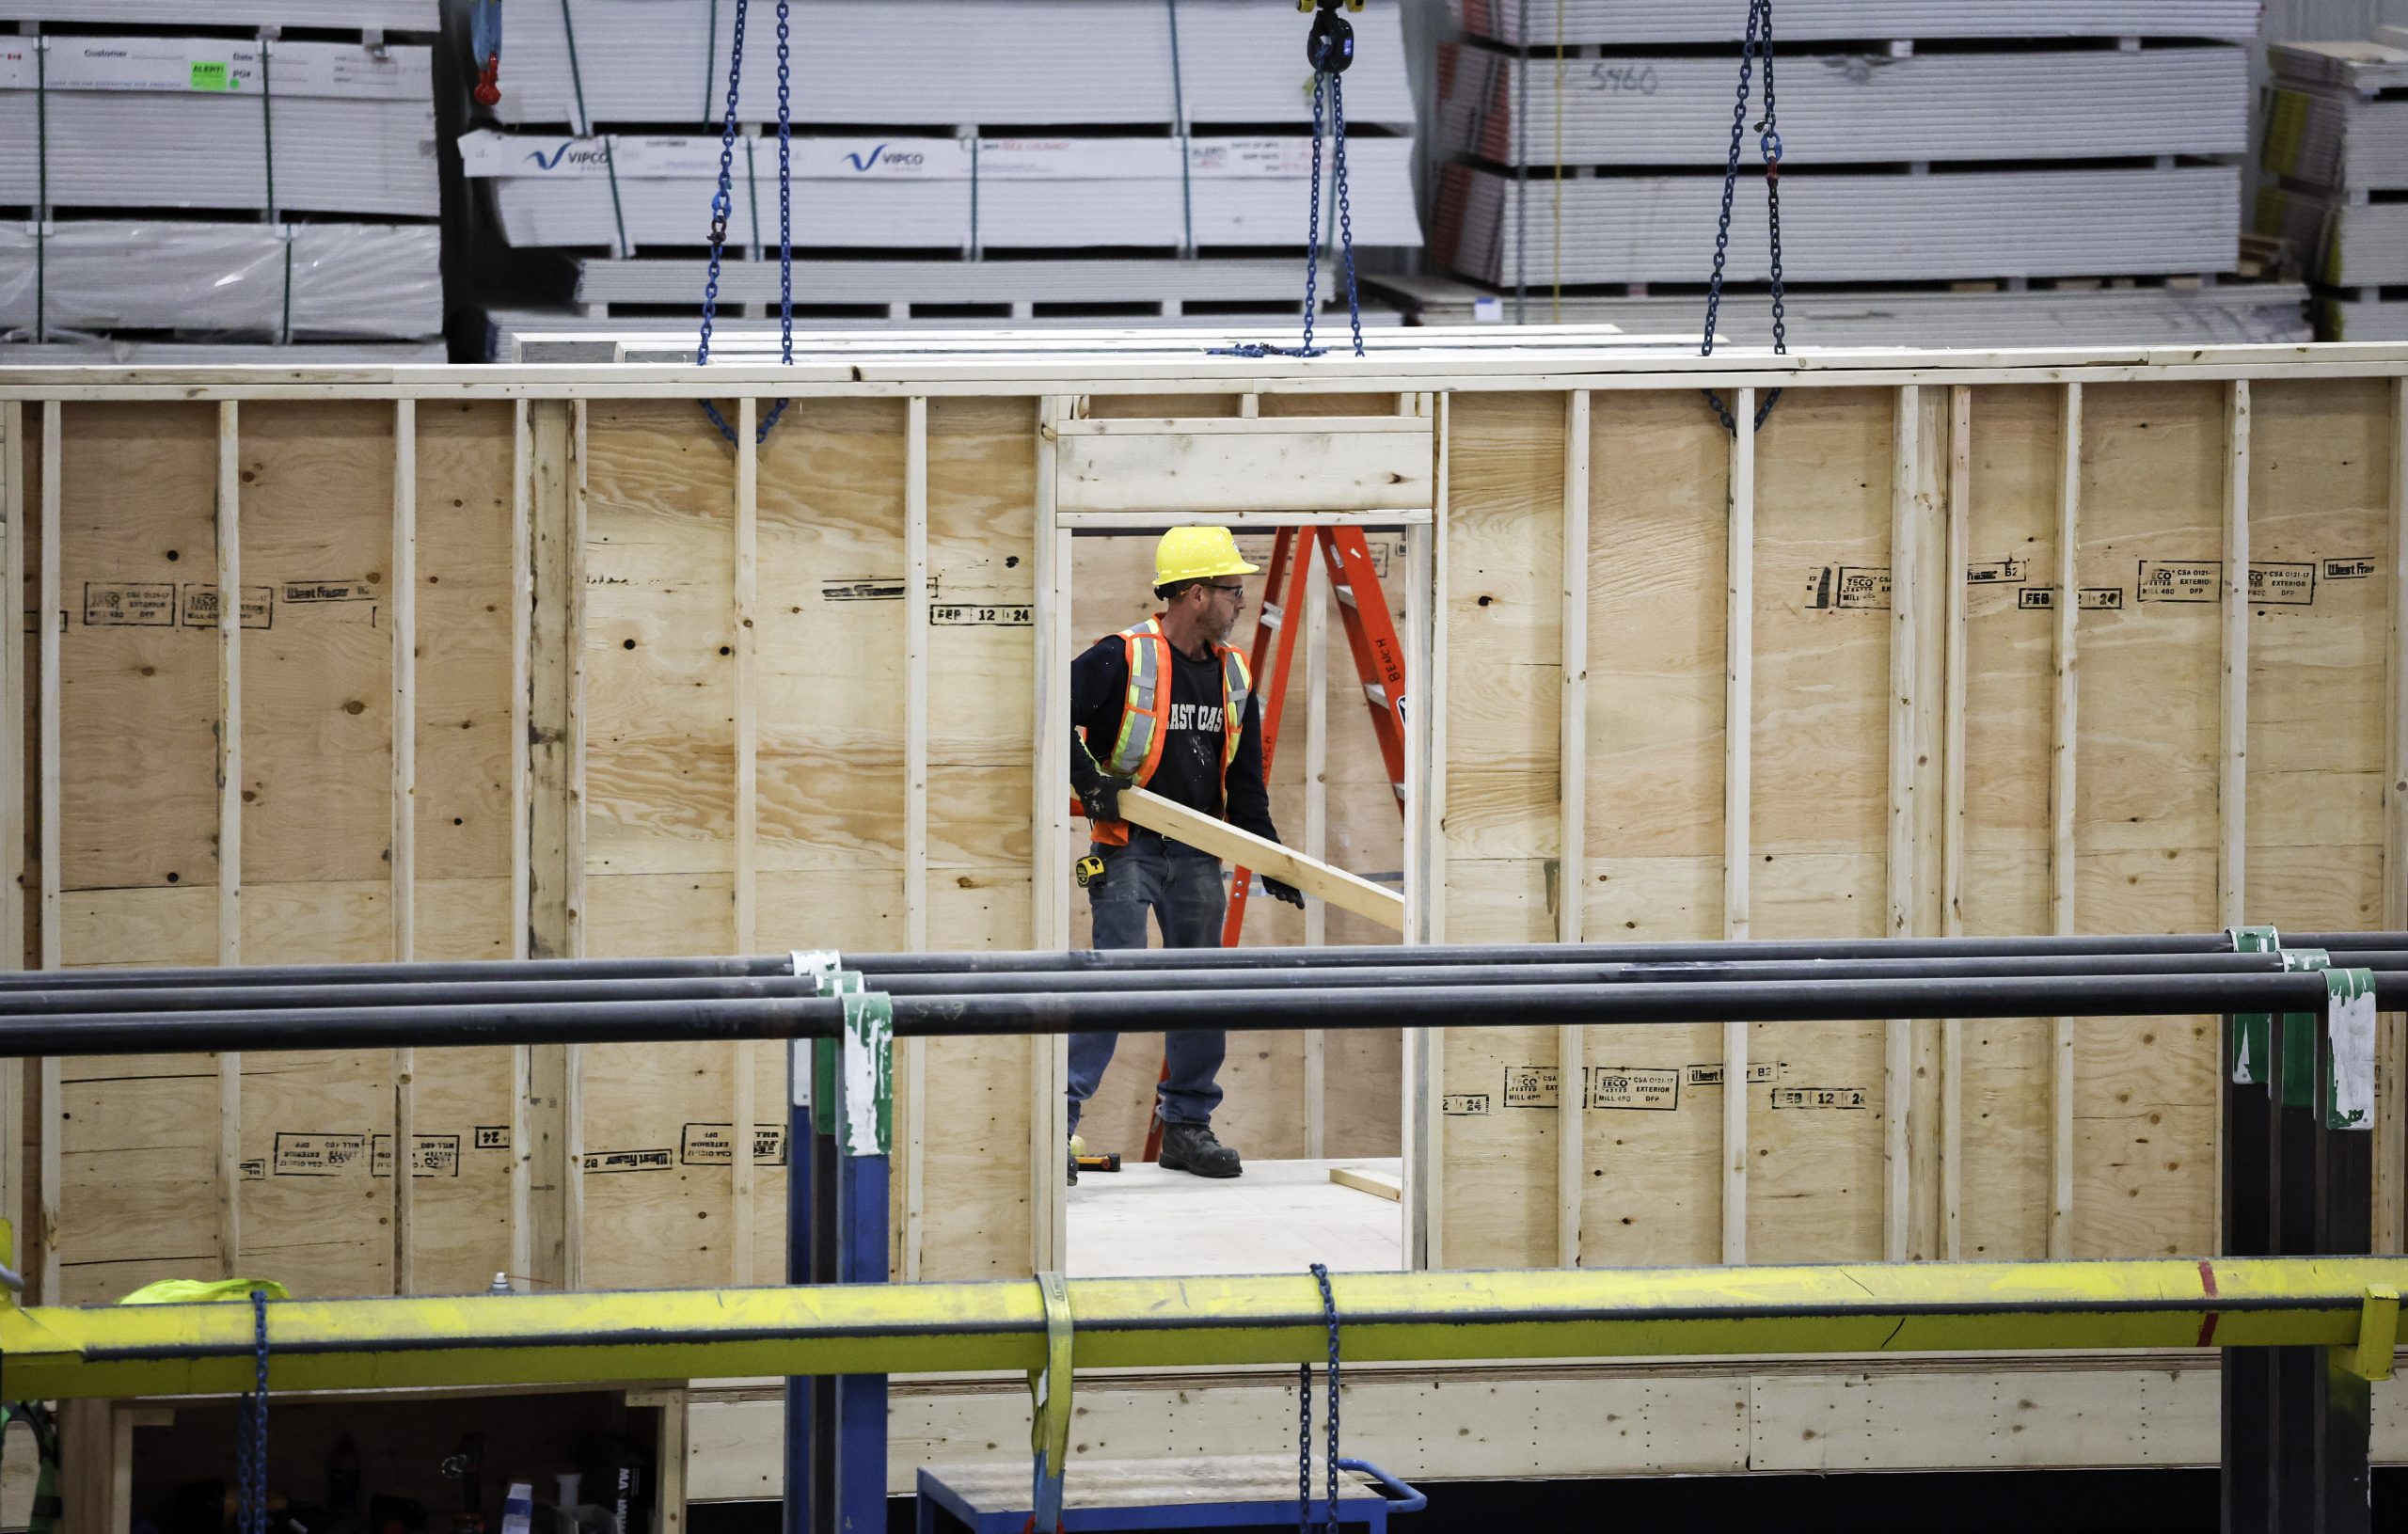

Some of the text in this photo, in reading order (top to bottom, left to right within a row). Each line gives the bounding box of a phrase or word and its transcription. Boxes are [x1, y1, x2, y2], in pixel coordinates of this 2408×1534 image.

[1590, 62, 1657, 95] 5460
[568, 151, 610, 165] VIPCO
[882, 152, 924, 166] VIPCO
[2025, 593, 2050, 604] FEB
[978, 609, 996, 621] 12
[1013, 609, 1029, 621] 24
[1166, 704, 1196, 730] AST
[1602, 1079, 1628, 1087] TECO
[1817, 1092, 1834, 1104] 12
[483, 1131, 499, 1144] 24
[584, 1158, 598, 1168] B2
